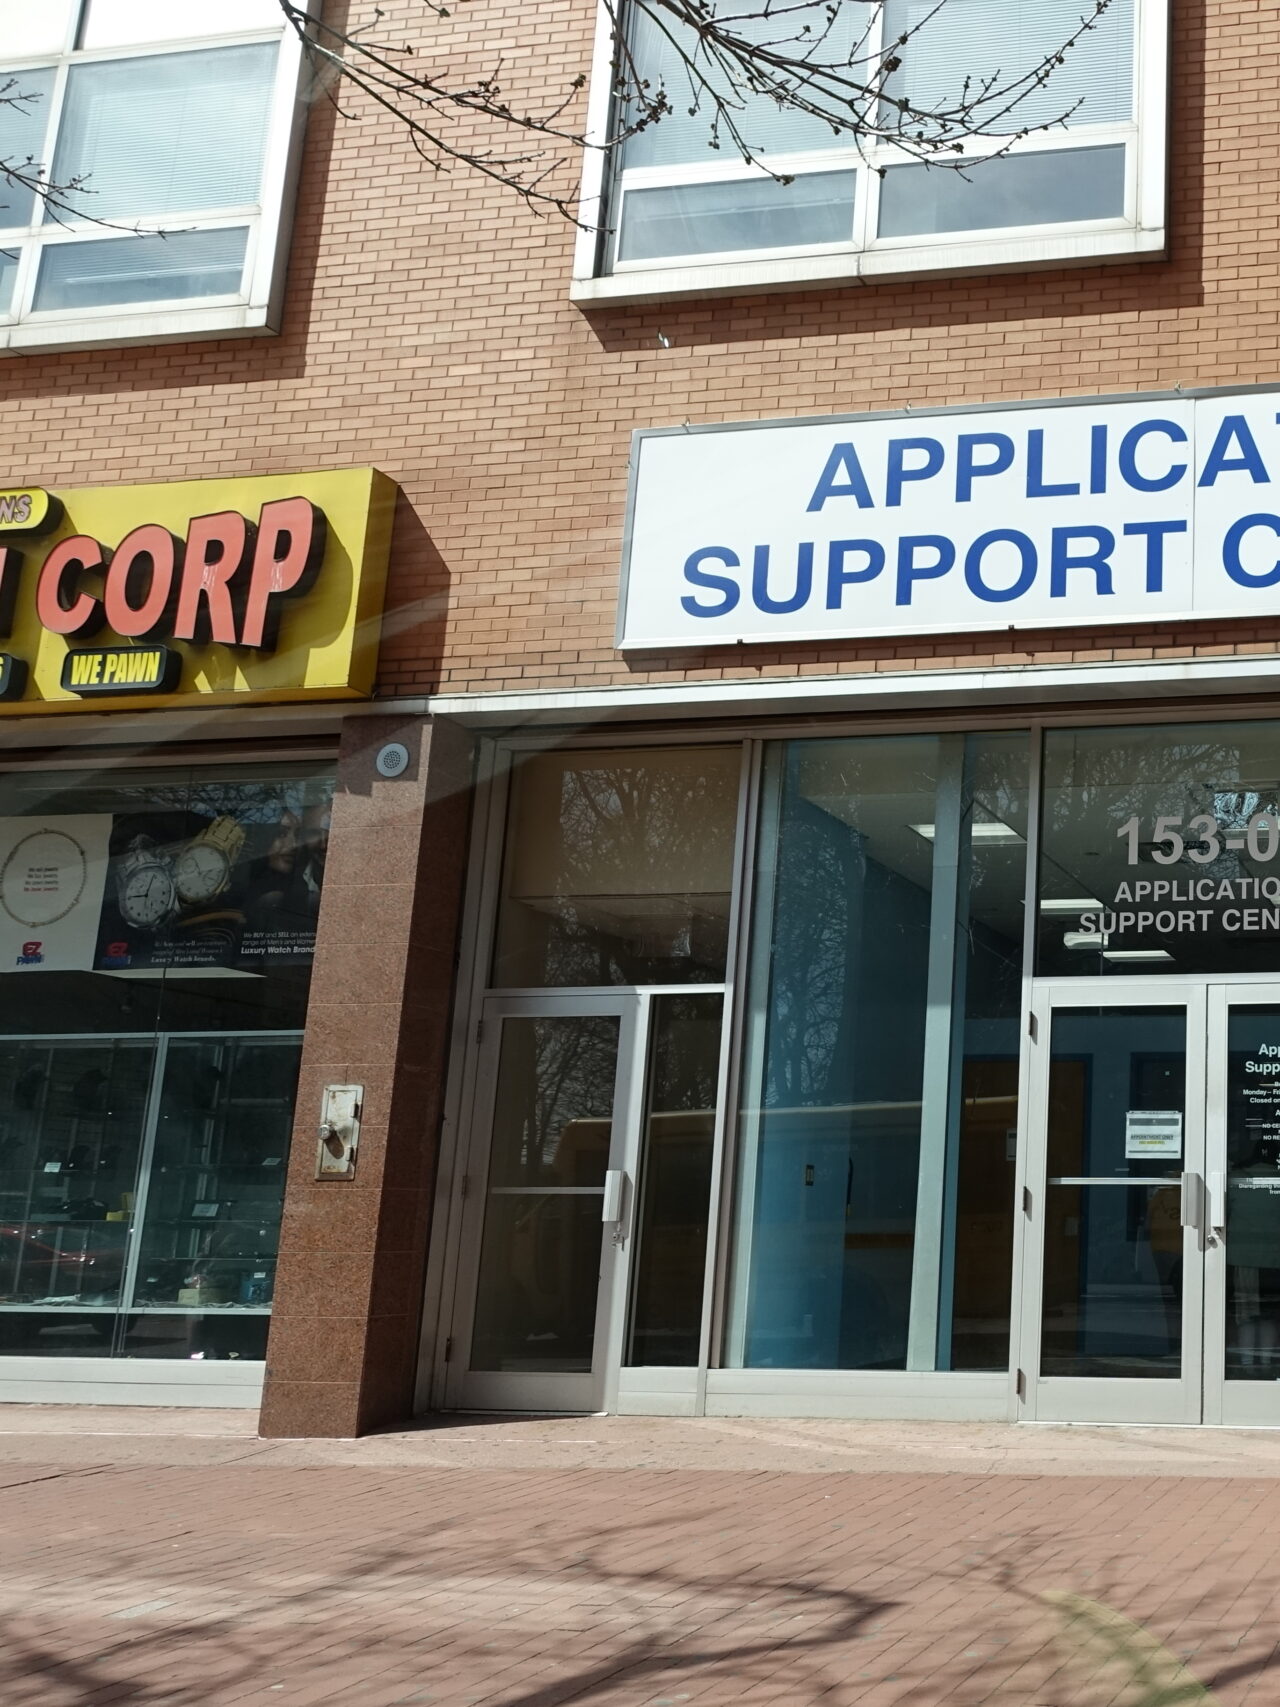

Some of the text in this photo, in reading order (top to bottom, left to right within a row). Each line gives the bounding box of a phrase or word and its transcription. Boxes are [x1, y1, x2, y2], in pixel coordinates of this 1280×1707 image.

[36, 496, 314, 648] CORP
[680, 520, 1187, 618] SUPPORT
[70, 652, 161, 685] WE PAWN
[1079, 910, 1214, 935] SUPPORT
[241, 946, 266, 956] Luxury
[267, 946, 292, 954] Watch
